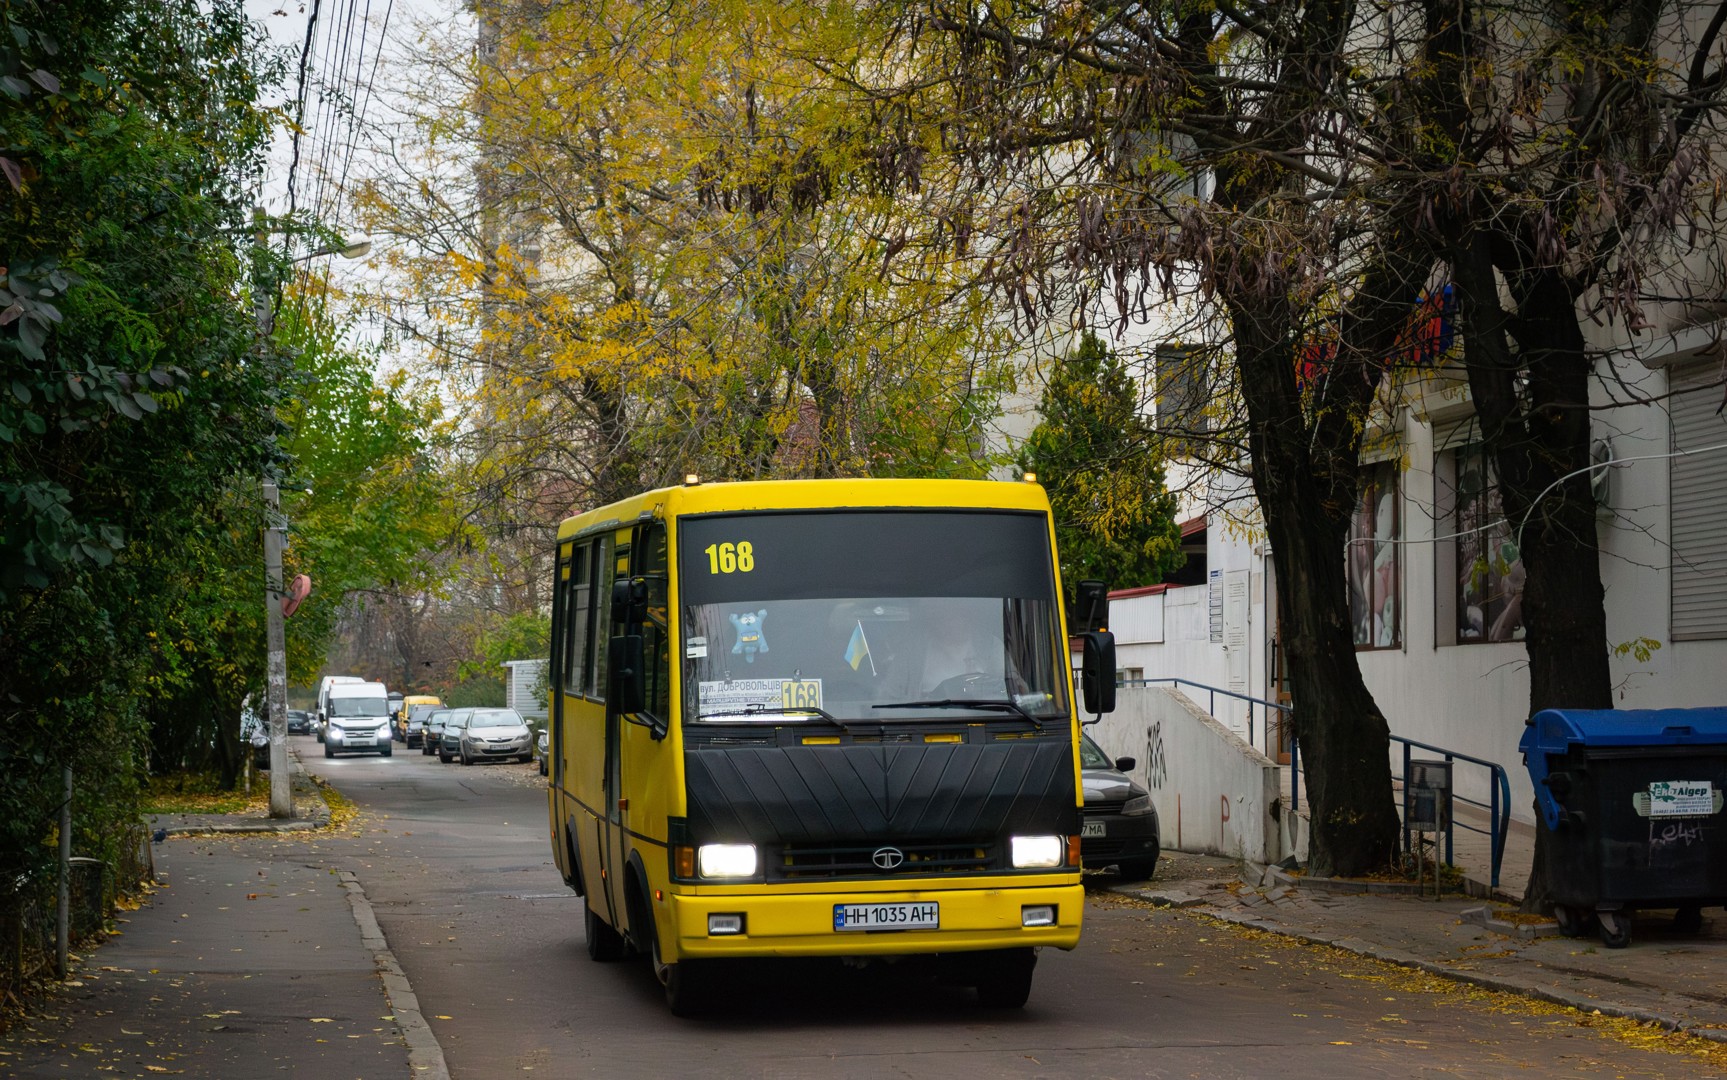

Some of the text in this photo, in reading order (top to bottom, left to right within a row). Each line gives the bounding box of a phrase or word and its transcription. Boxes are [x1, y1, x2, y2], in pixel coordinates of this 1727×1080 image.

[705, 541, 754, 574] 168
[700, 685, 716, 695] вул.
[718, 680, 781, 693] ДОБРОВОЛЬЦІВ
[785, 683, 818, 710] 168
[1089, 825, 1103, 835] MA
[845, 906, 933, 924] HH 1035 AH
